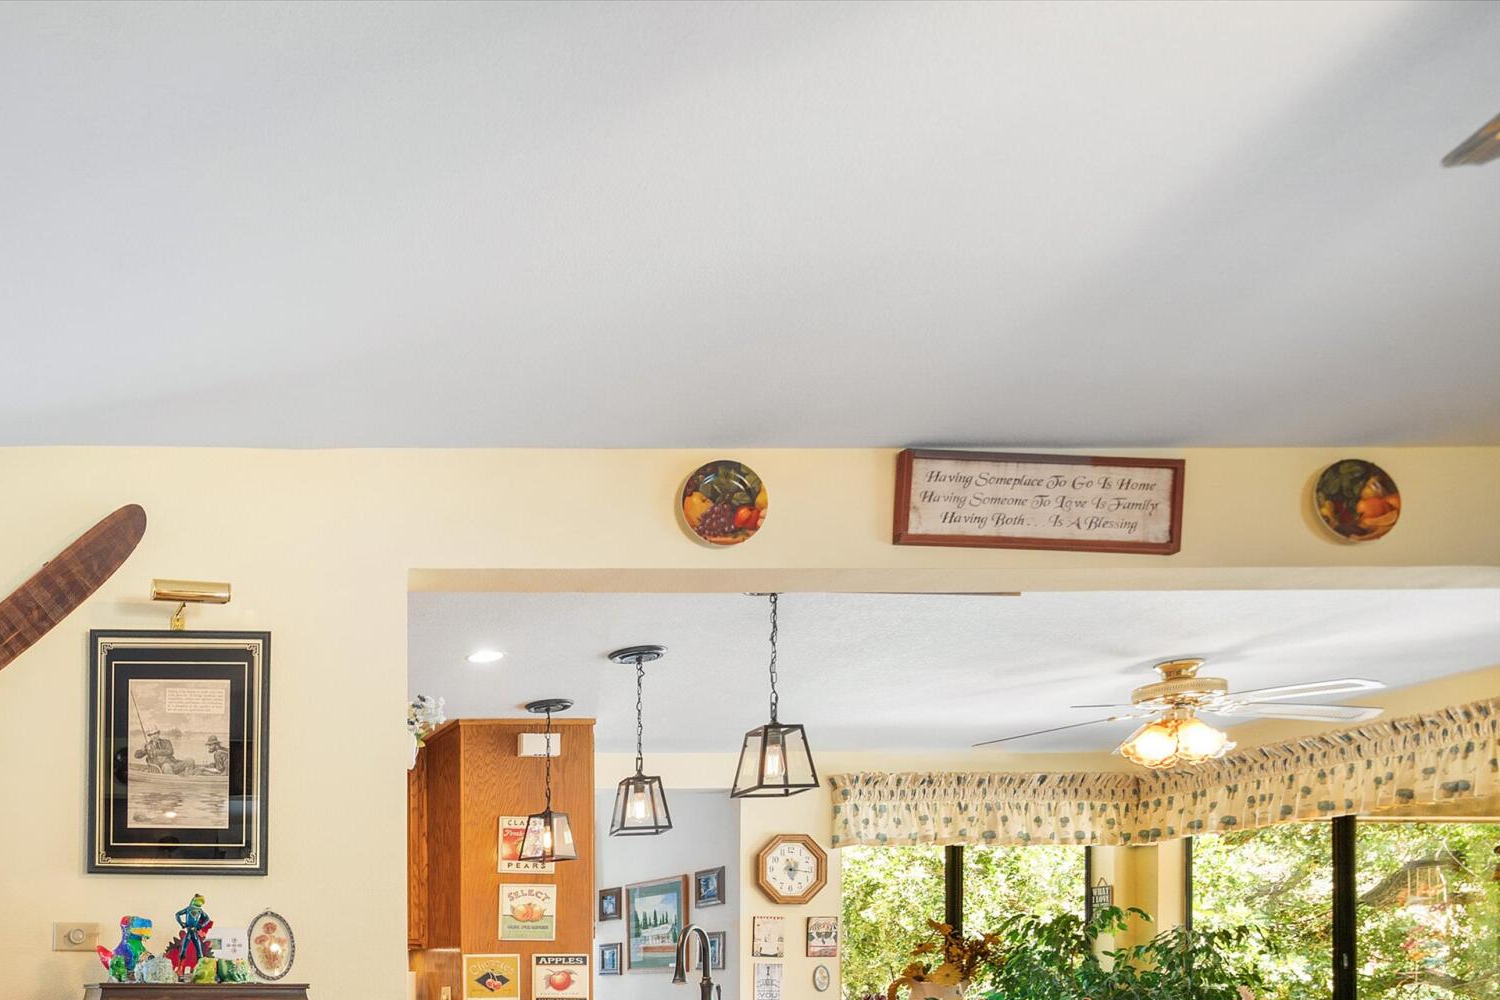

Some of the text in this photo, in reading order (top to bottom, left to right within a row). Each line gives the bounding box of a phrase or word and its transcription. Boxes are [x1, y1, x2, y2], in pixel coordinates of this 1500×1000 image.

[926, 471, 1156, 491] Having Someplace To Go Is Home
[920, 491, 1160, 516] Having Someone To Love Is Family
[940, 512, 988, 529] Having
[1049, 515, 1063, 527] Is
[1066, 516, 1082, 531] A
[1084, 516, 1138, 534] Blessing
[507, 889, 551, 902] SELECT
[1092, 887, 1109, 895] WHAT
[1096, 895, 1109, 903] LOVE
[539, 957, 584, 965] APPLES
